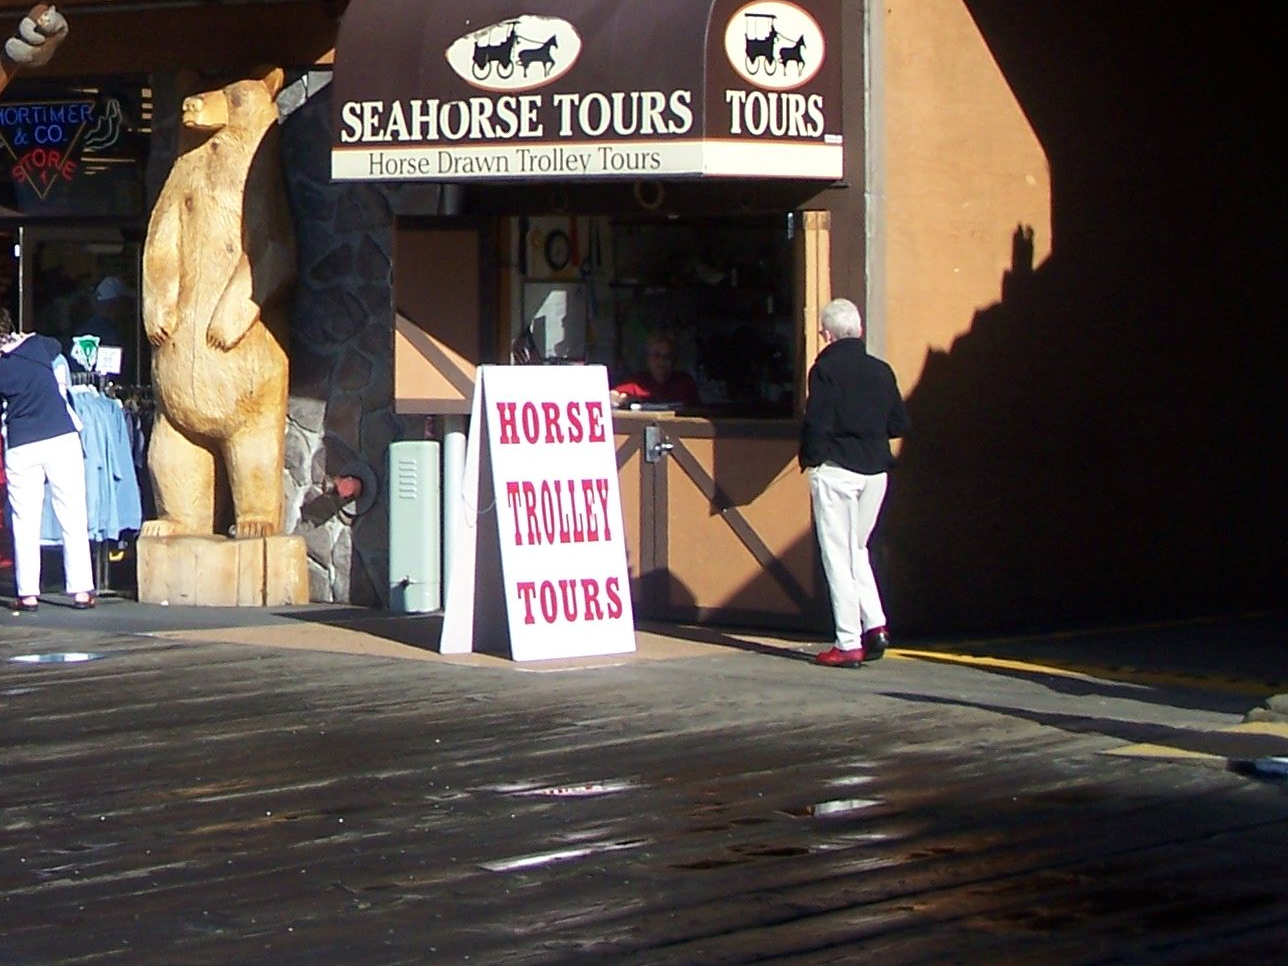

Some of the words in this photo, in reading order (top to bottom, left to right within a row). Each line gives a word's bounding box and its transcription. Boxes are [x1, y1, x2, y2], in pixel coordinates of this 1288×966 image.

[14, 126, 29, 145] &
[340, 93, 544, 144] SEAHORSE
[553, 90, 695, 139] TOURS
[725, 88, 825, 137] TOURS
[12, 148, 77, 183] STORE
[368, 150, 430, 176] Horse
[437, 149, 510, 174] Drawn
[515, 147, 592, 174] Trolley
[597, 147, 662, 171] Tours
[496, 401, 606, 445] HORSE
[506, 478, 612, 546] TROLLEY
[516, 576, 624, 625] TOURS
